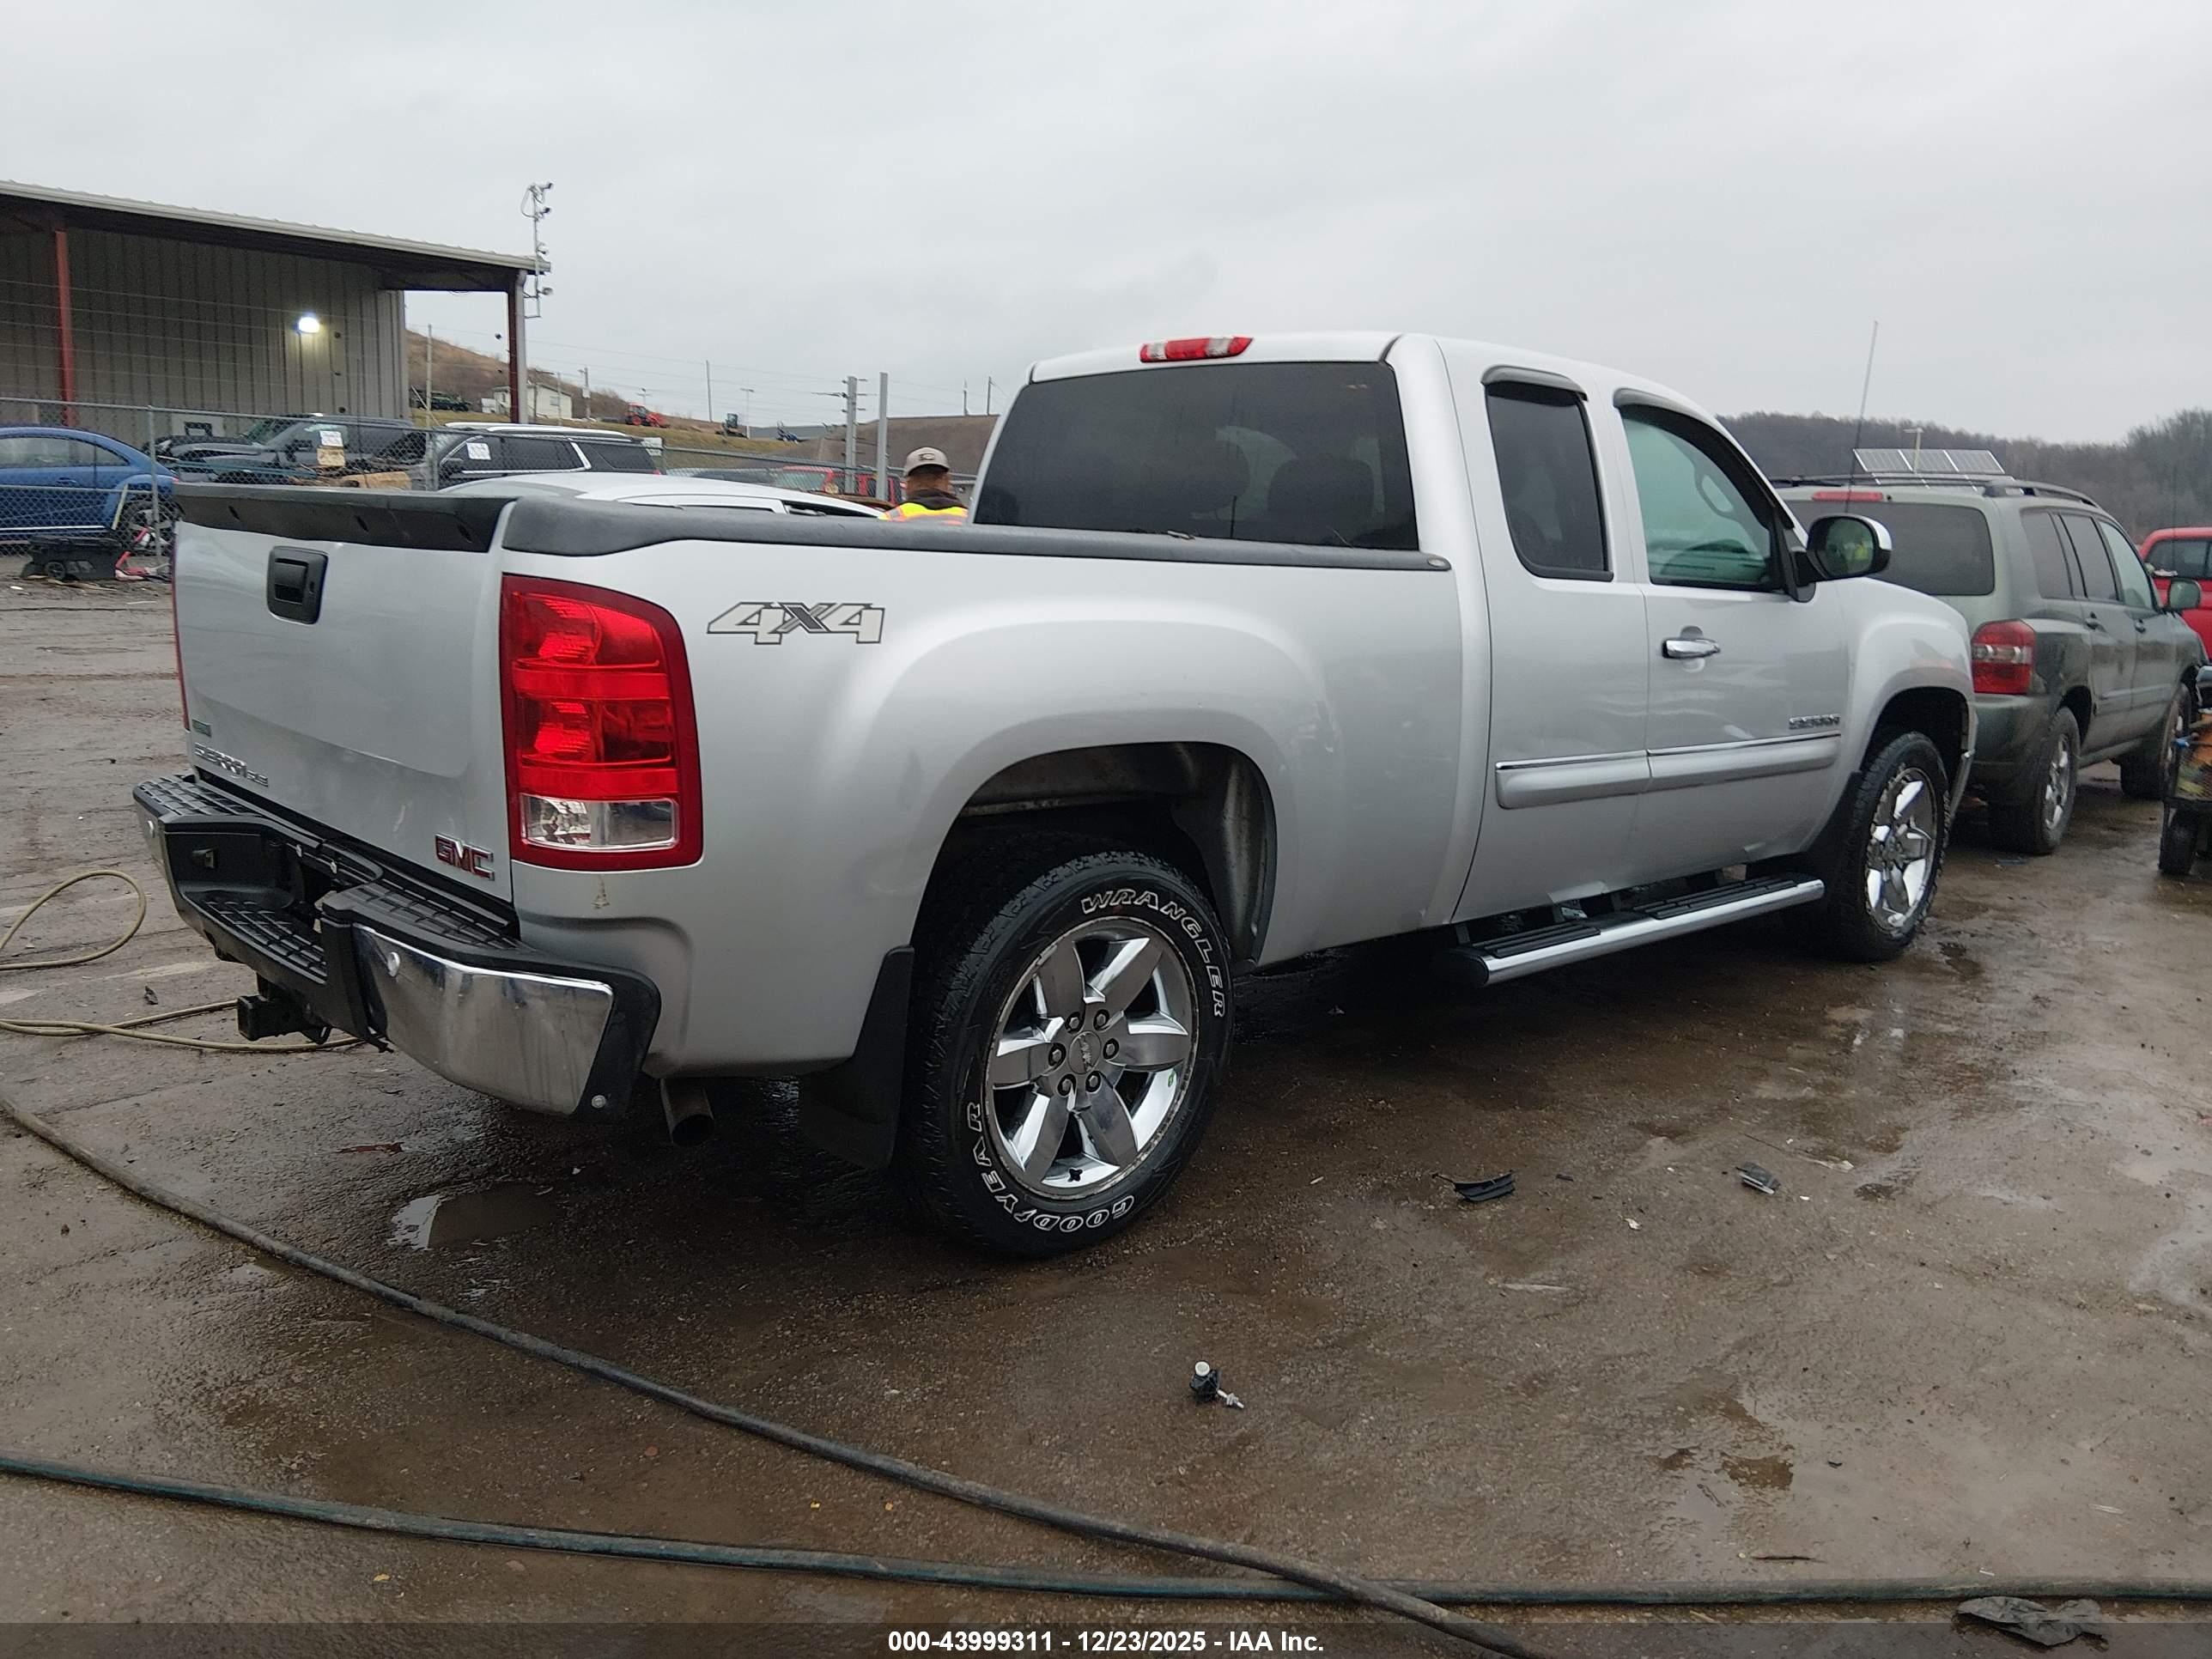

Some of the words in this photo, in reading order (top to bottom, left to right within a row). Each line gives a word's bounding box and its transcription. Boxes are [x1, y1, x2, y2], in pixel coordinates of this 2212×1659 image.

[434, 833, 495, 882] GMC
[1081, 888, 1226, 1018] WRANGLER
[967, 1103, 1134, 1233] GOODYEAR
